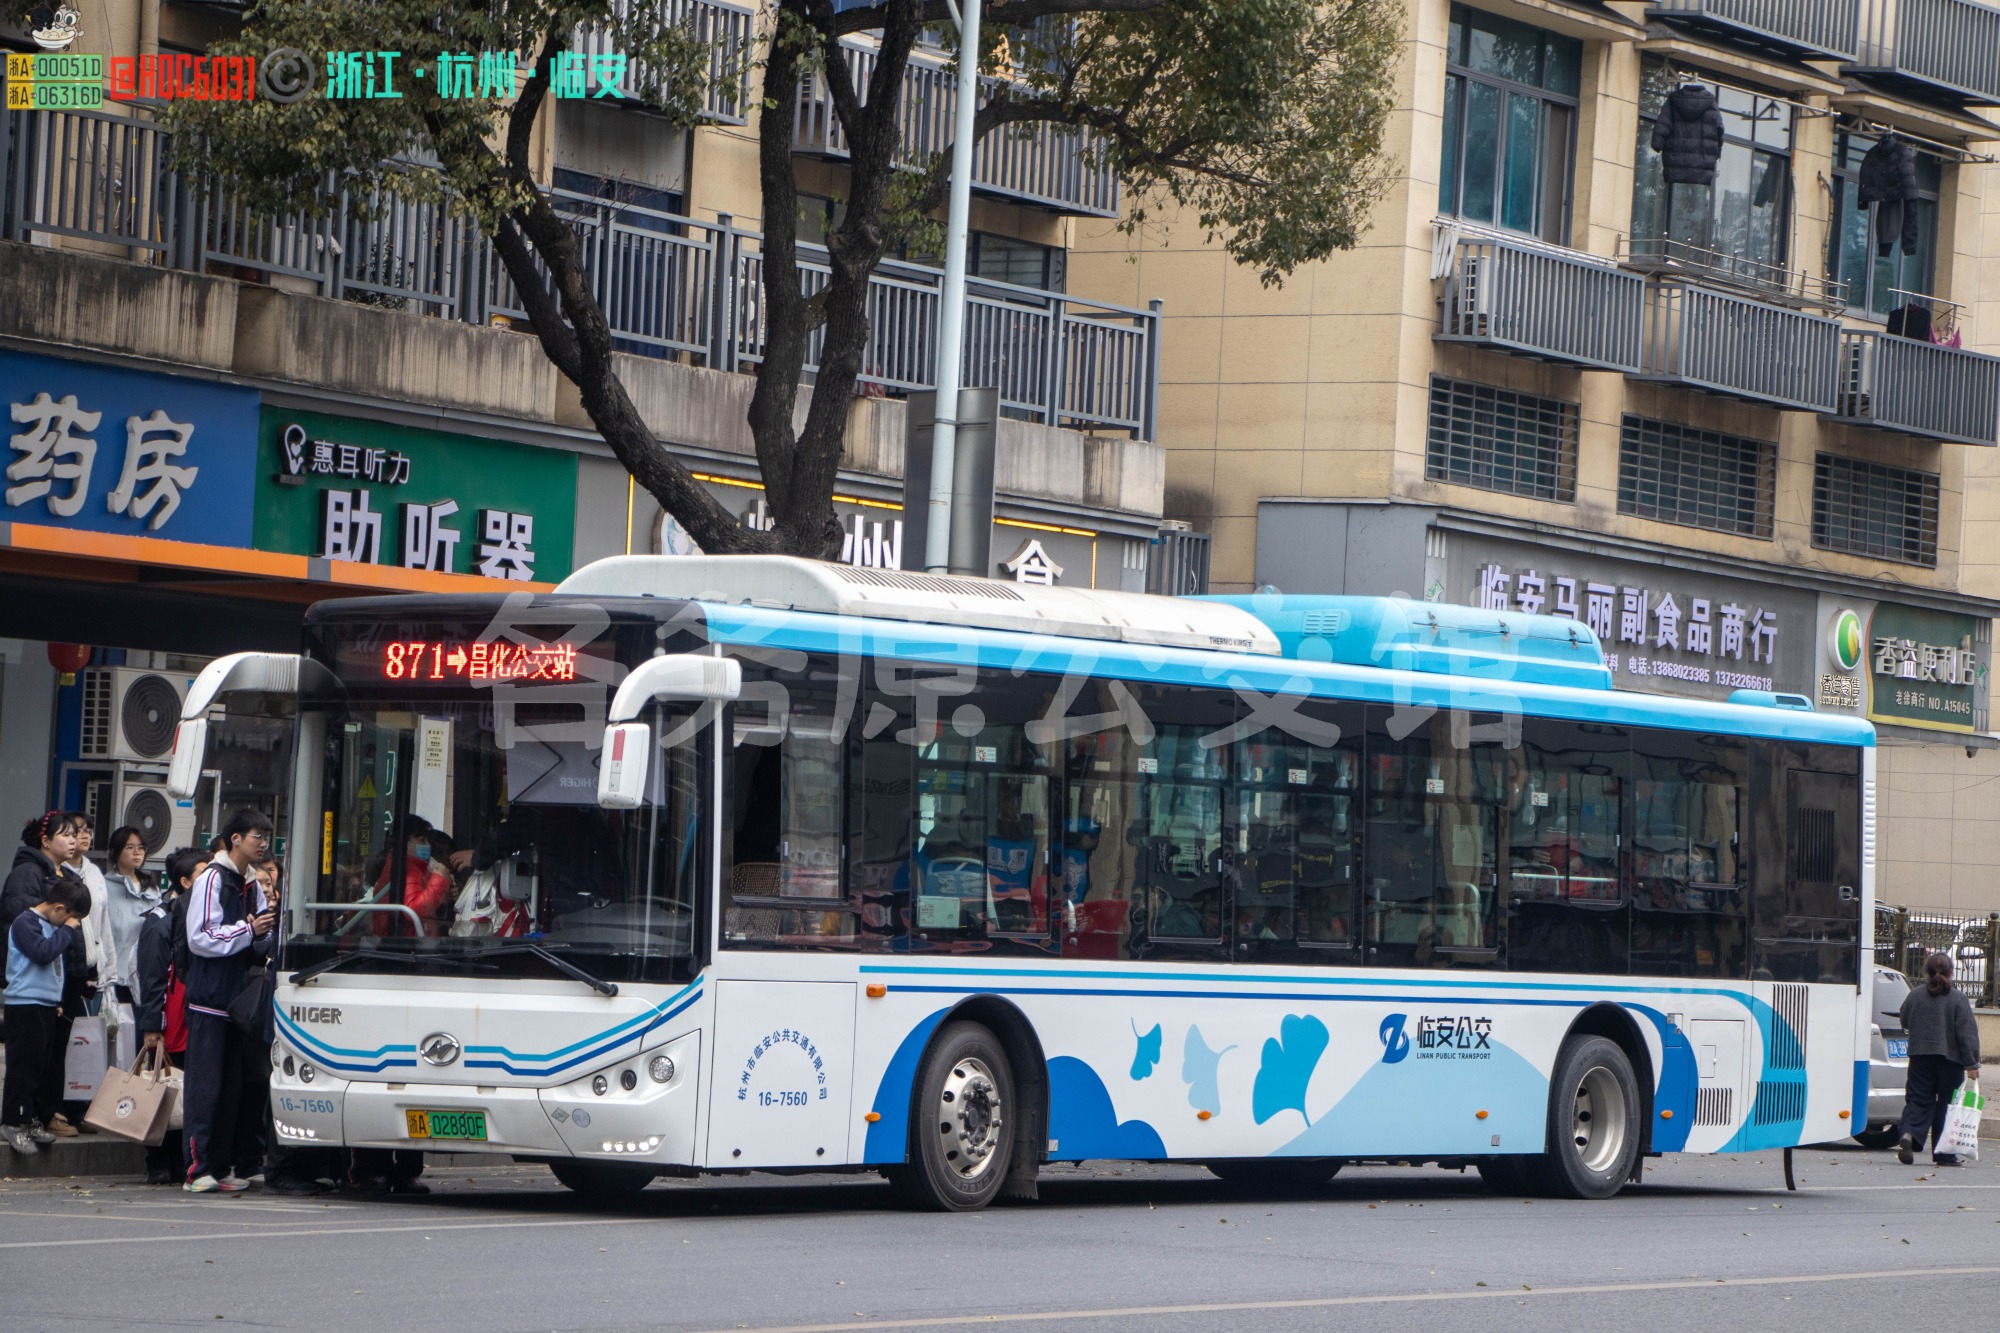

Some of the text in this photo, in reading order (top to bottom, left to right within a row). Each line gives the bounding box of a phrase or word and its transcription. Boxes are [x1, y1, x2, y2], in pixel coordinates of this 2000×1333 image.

[6, 392, 199, 531] 药房
[311, 440, 411, 485] 惠耳听力
[318, 488, 536, 583] 助听器
[386, 643, 577, 679] 871 昌化公交站
[1715, 670, 1773, 692] 13732266618
[290, 1005, 342, 1025] HIGER
[1416, 1015, 1493, 1049] 临安公交
[737, 1028, 827, 1100] 杭州市临安公共交通有限公司
[1416, 1052, 1434, 1060] LINAN
[1435, 1052, 1456, 1060] PUBLIC
[280, 1096, 334, 1114] 16-7560
[758, 1091, 808, 1106] 16-7560
